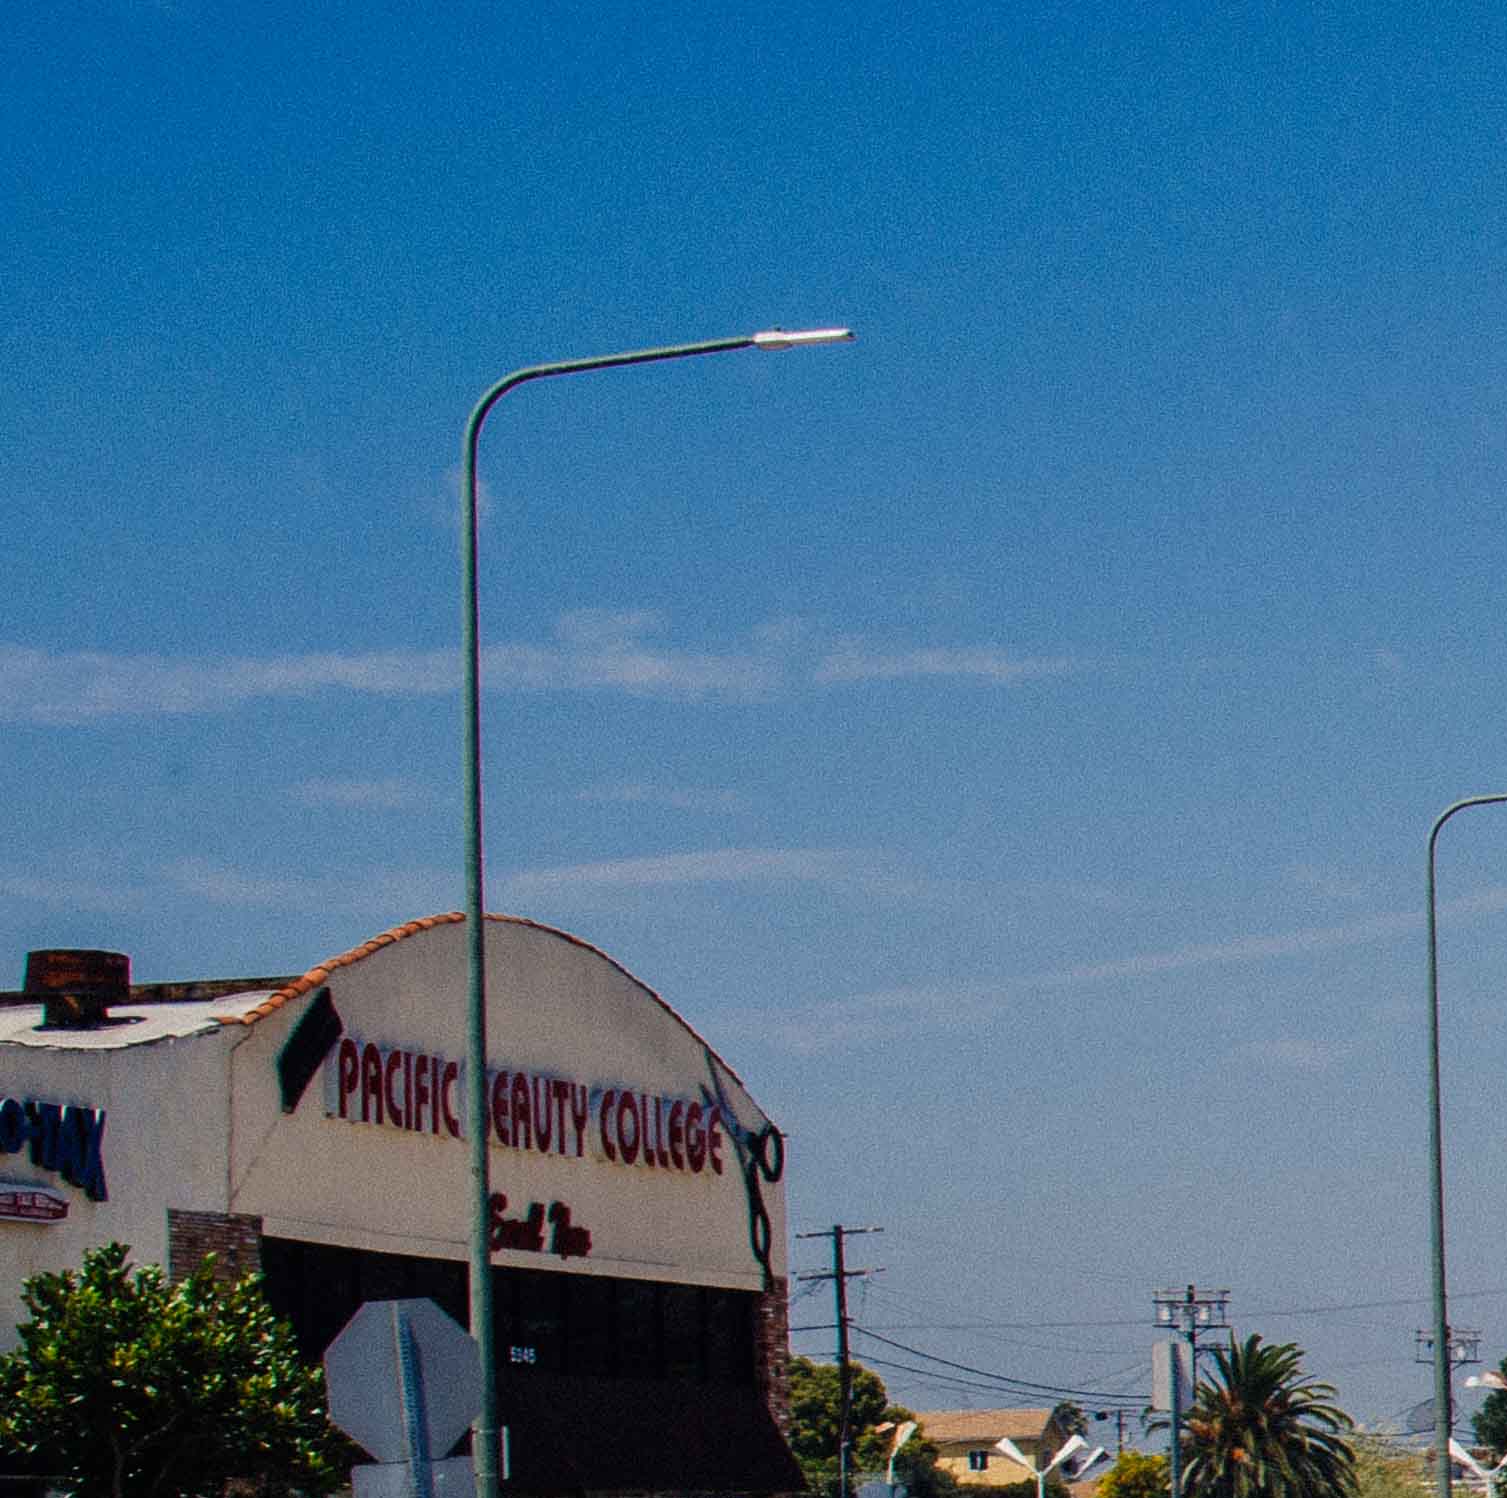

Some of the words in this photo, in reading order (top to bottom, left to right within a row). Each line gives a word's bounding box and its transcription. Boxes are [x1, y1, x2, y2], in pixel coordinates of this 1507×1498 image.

[338, 1039, 461, 1138] PACIFIC
[484, 1070, 588, 1158] EAUTY
[601, 1089, 723, 1175] COLLEGE
